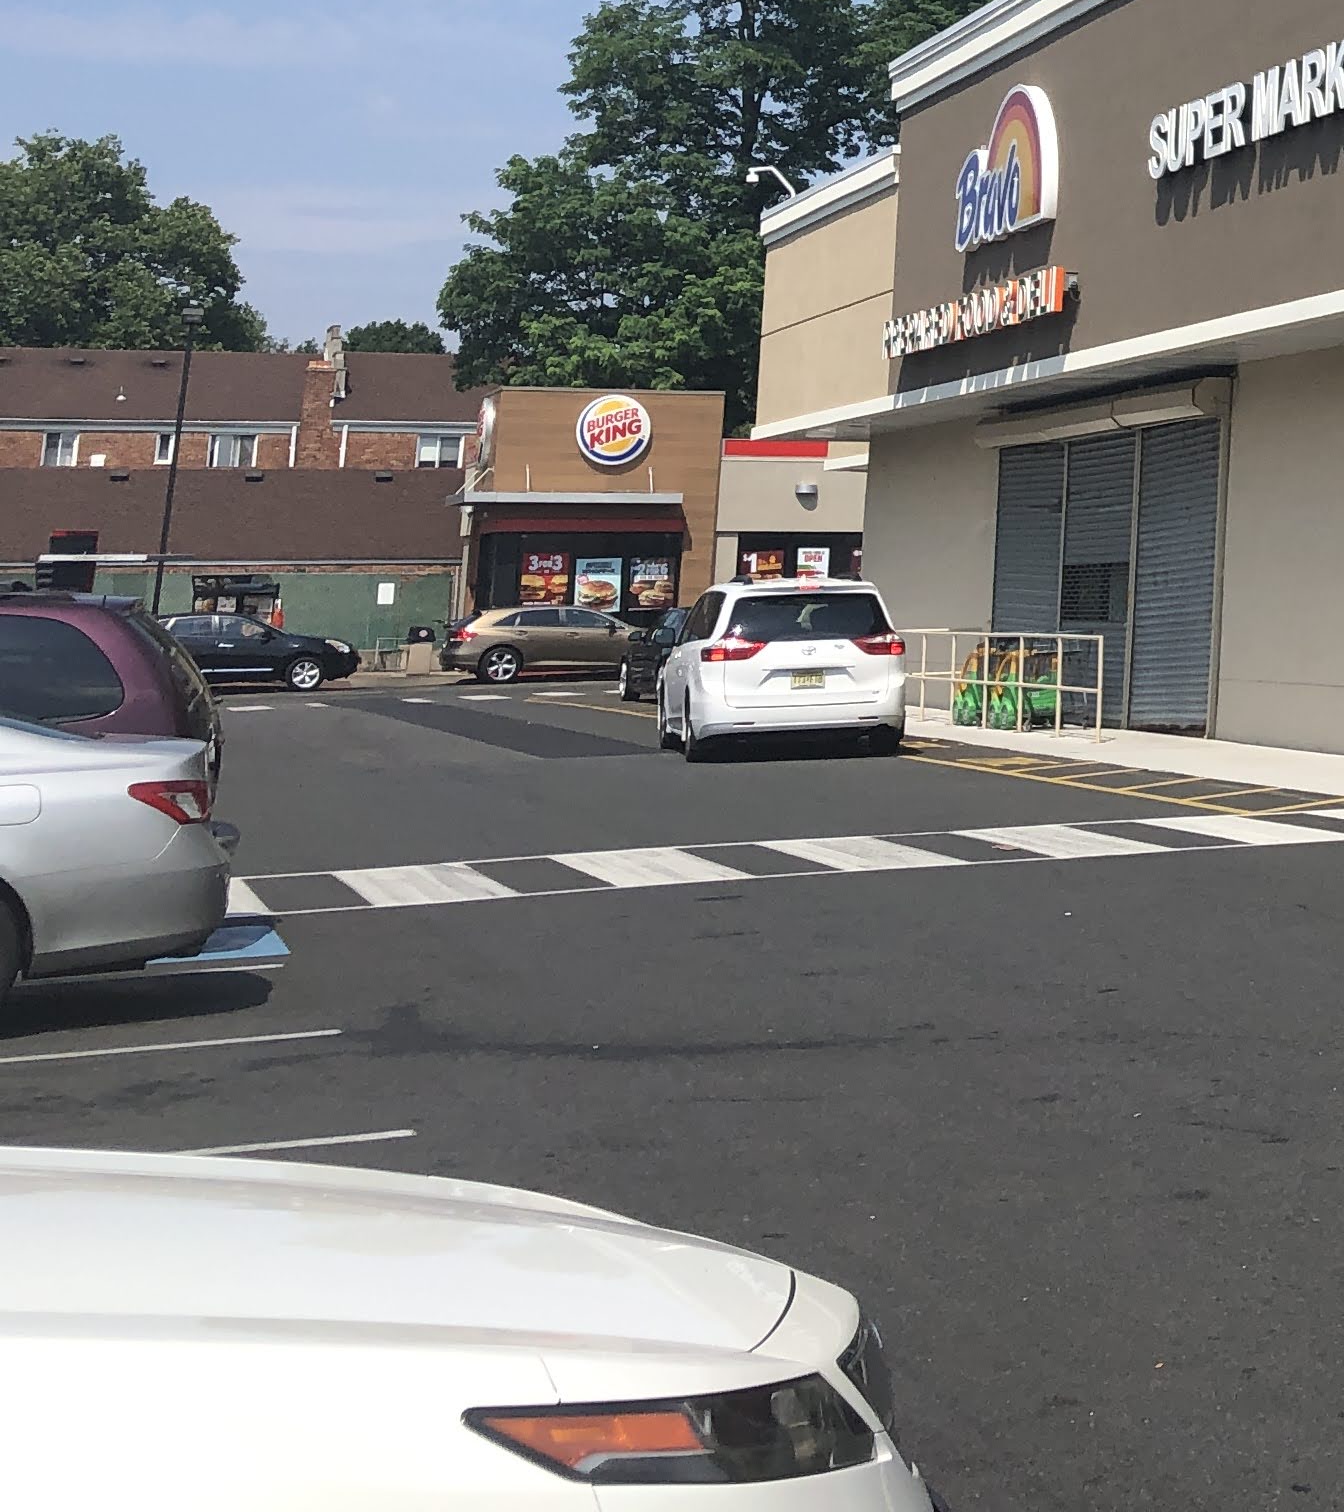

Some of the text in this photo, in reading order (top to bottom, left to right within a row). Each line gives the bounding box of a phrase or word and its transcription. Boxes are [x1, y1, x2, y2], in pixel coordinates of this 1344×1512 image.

[1148, 82, 1245, 179] SUPER
[956, 140, 1020, 252] Bravo
[882, 303, 953, 360] PREPARED
[955, 287, 1001, 341] FOOD
[1017, 266, 1064, 319] DELI
[587, 407, 639, 433] BURGER
[590, 419, 642, 450] KING
[804, 553, 823, 563] OPEN
